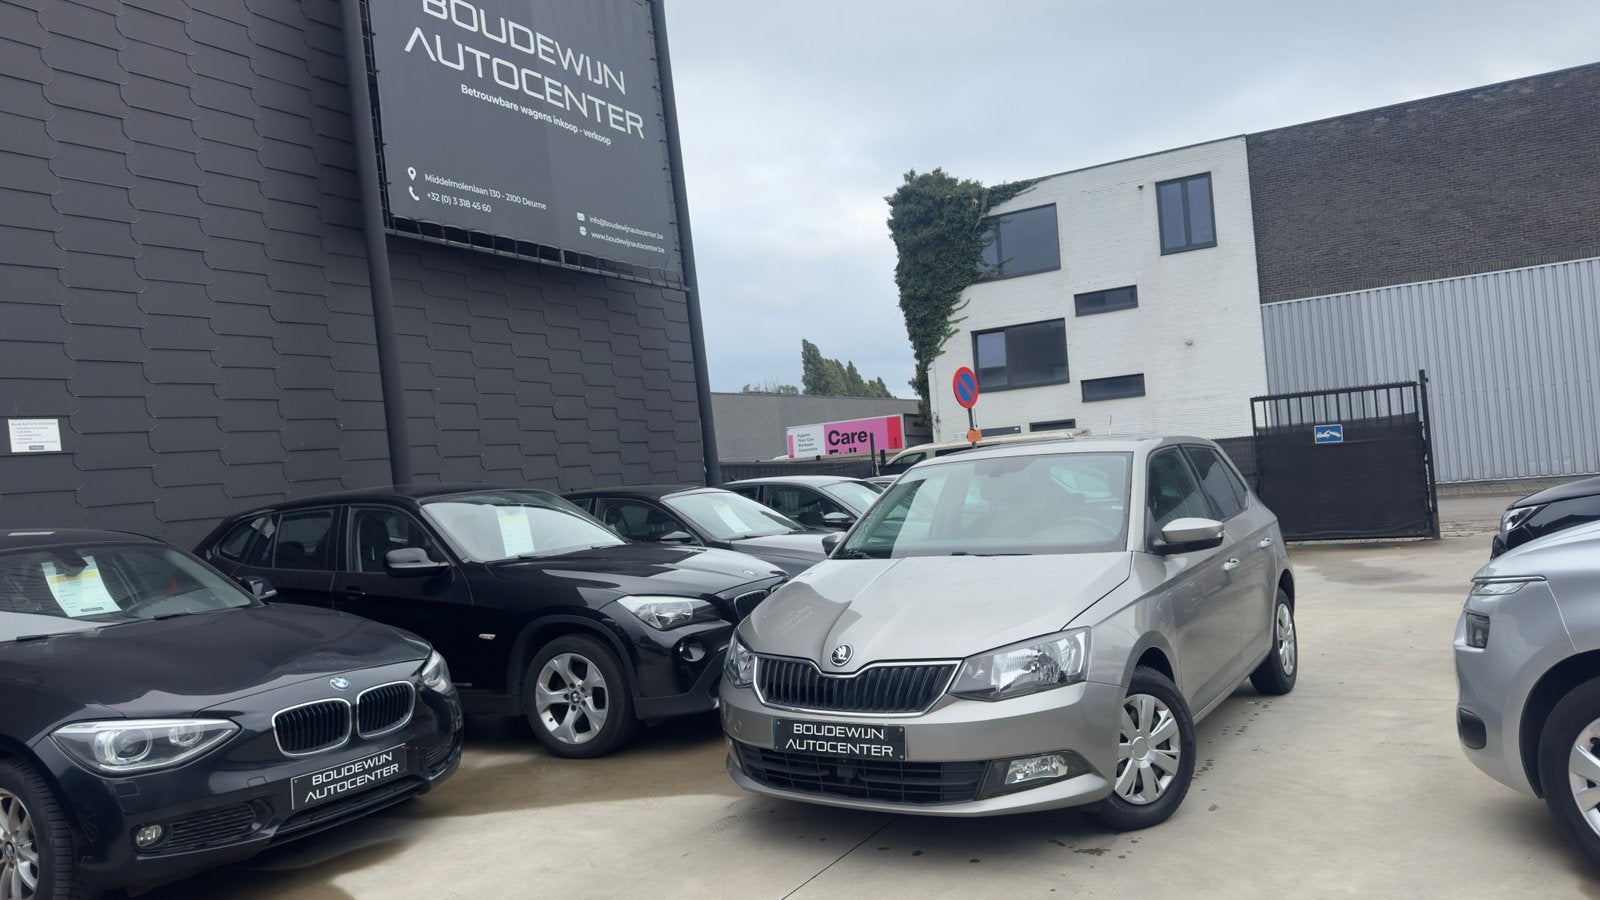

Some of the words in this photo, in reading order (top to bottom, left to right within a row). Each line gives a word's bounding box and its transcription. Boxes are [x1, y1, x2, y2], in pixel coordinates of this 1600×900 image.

[404, 27, 645, 139] AUTOCENTER
[460, 84, 519, 112] Betrouwbare
[520, 104, 552, 123] wagens
[552, 115, 578, 134] inkoop
[583, 128, 612, 146] verkoop
[425, 174, 488, 195] Middelmolenlaan
[489, 188, 501, 199] 130
[505, 193, 522, 204] 2100
[522, 197, 547, 210] Deurne
[427, 192, 441, 202] +32
[441, 194, 452, 206] (0)
[452, 197, 459, 205] 3
[459, 198, 471, 208] 318
[472, 202, 482, 211] 45
[482, 203, 492, 213] 60
[828, 429, 868, 446] Care
[785, 738, 893, 757] AUTOCENTER
[793, 723, 884, 740] BOUDEWIJN
[304, 763, 399, 803] AUTOCENTER
[312, 751, 393, 786] BOUDEWIJN
